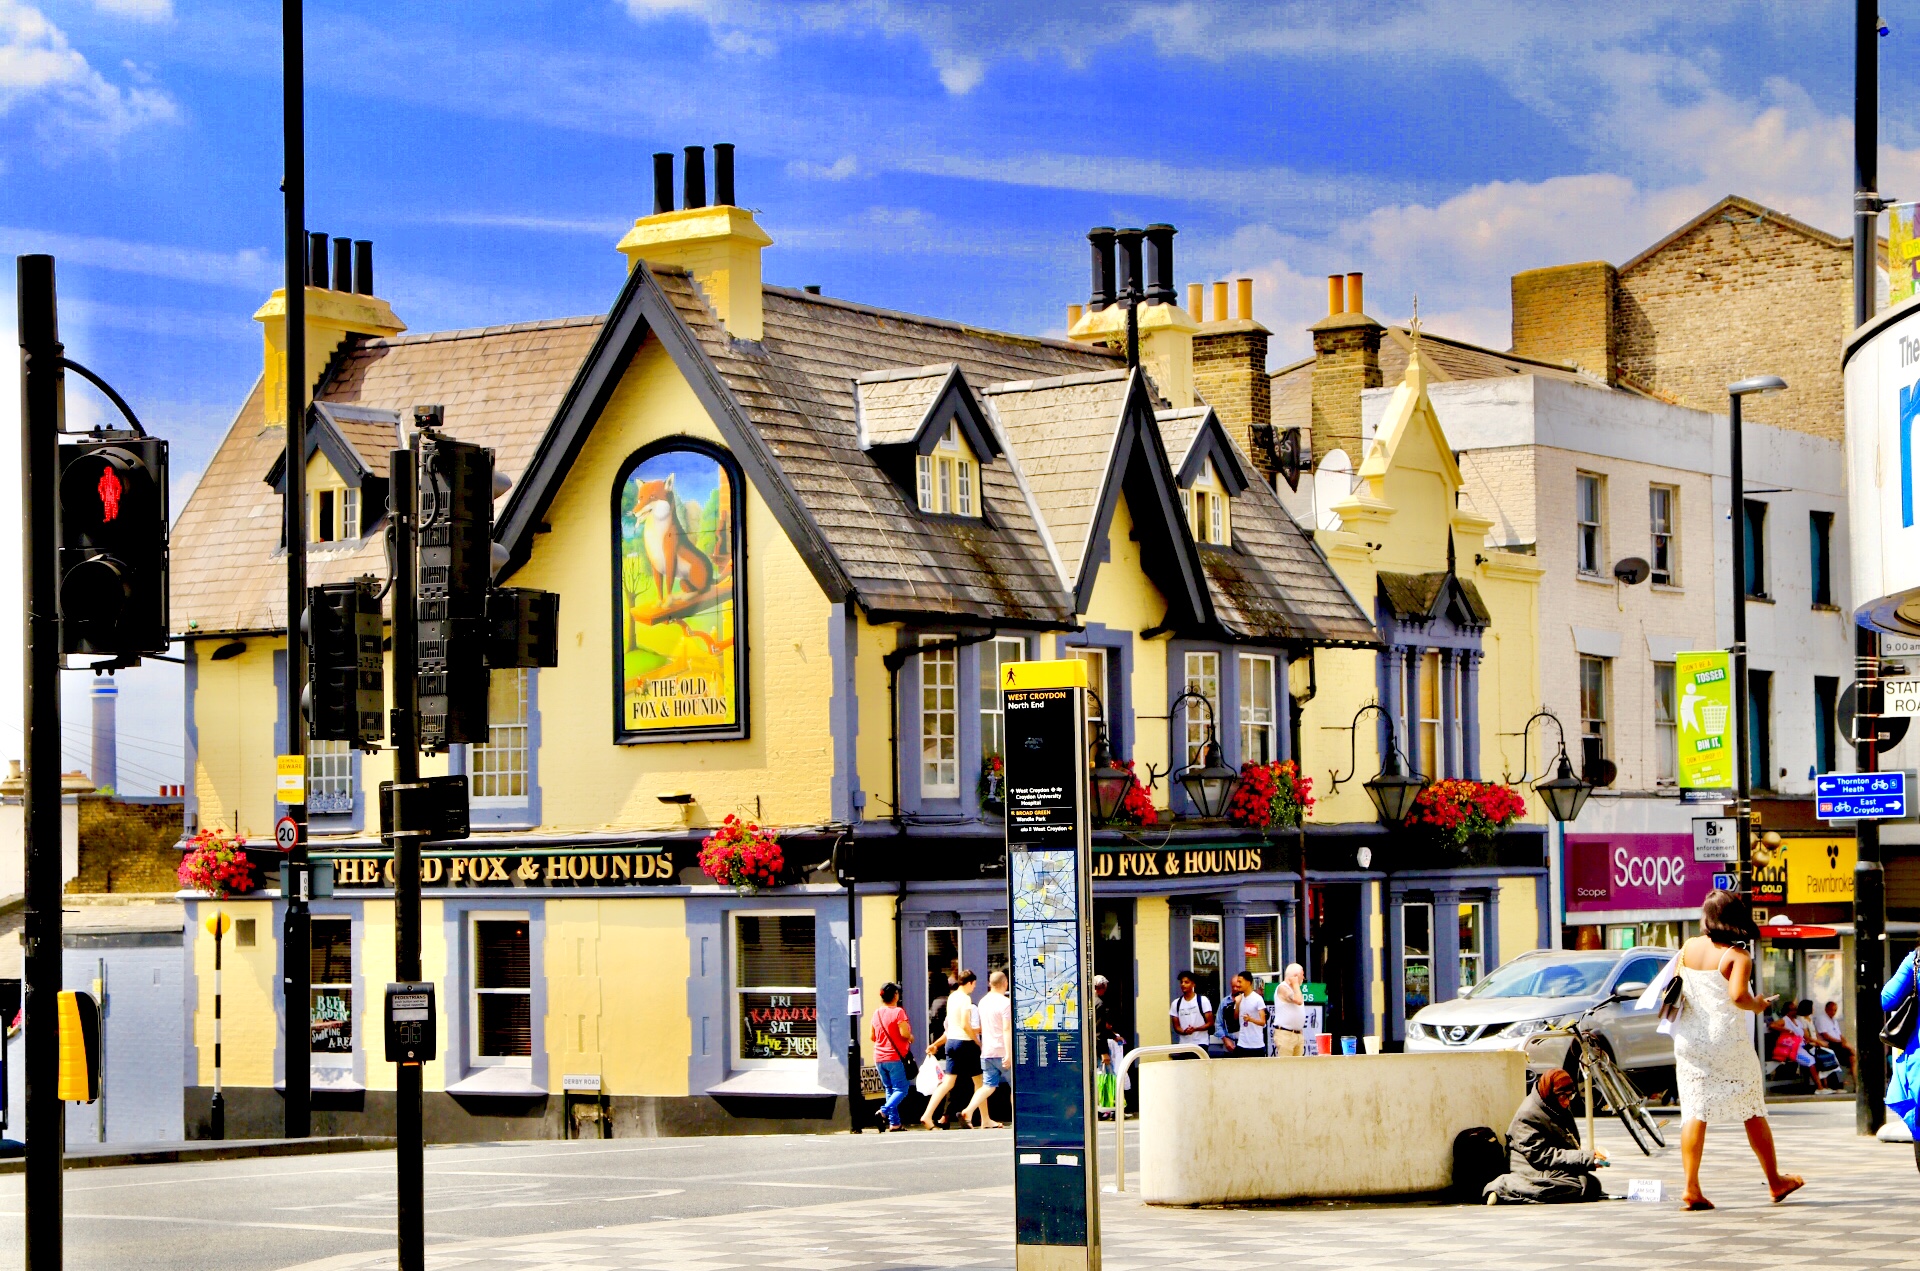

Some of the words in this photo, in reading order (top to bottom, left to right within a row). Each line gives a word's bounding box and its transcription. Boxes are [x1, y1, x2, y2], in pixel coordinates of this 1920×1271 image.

[1886, 643, 1908, 652] 9.00
[1696, 669, 1724, 683] TOSSER
[652, 680, 676, 697] THE
[680, 678, 706, 695] OLD
[1029, 692, 1066, 700] CROYDON
[633, 701, 657, 719] FOX
[660, 700, 670, 717] &
[674, 697, 727, 716] HOUNDS
[1008, 701, 1029, 709] North
[1031, 701, 1044, 709] End
[1697, 739, 1710, 751] BIN
[1836, 777, 1869, 785] Thornton
[1842, 785, 1865, 793] Heath
[1853, 806, 1884, 815] Croydon
[279, 827, 295, 842] 20
[451, 856, 510, 883] FOX
[517, 854, 541, 880] &
[545, 853, 674, 881] HOUNDS
[1118, 852, 1159, 877] FOX
[1165, 852, 1179, 875] &
[1184, 849, 1262, 874] HOUNDS
[1614, 847, 1685, 895] Scope
[1717, 876, 1726, 889] P
[1577, 887, 1607, 898] Scope
[1761, 885, 1783, 893] GOLD
[1196, 950, 1218, 967] IPA
[1302, 985, 1309, 993] &
[316, 996, 346, 1012] BEER
[770, 996, 792, 1007] FRI
[770, 1021, 793, 1035] SAT
